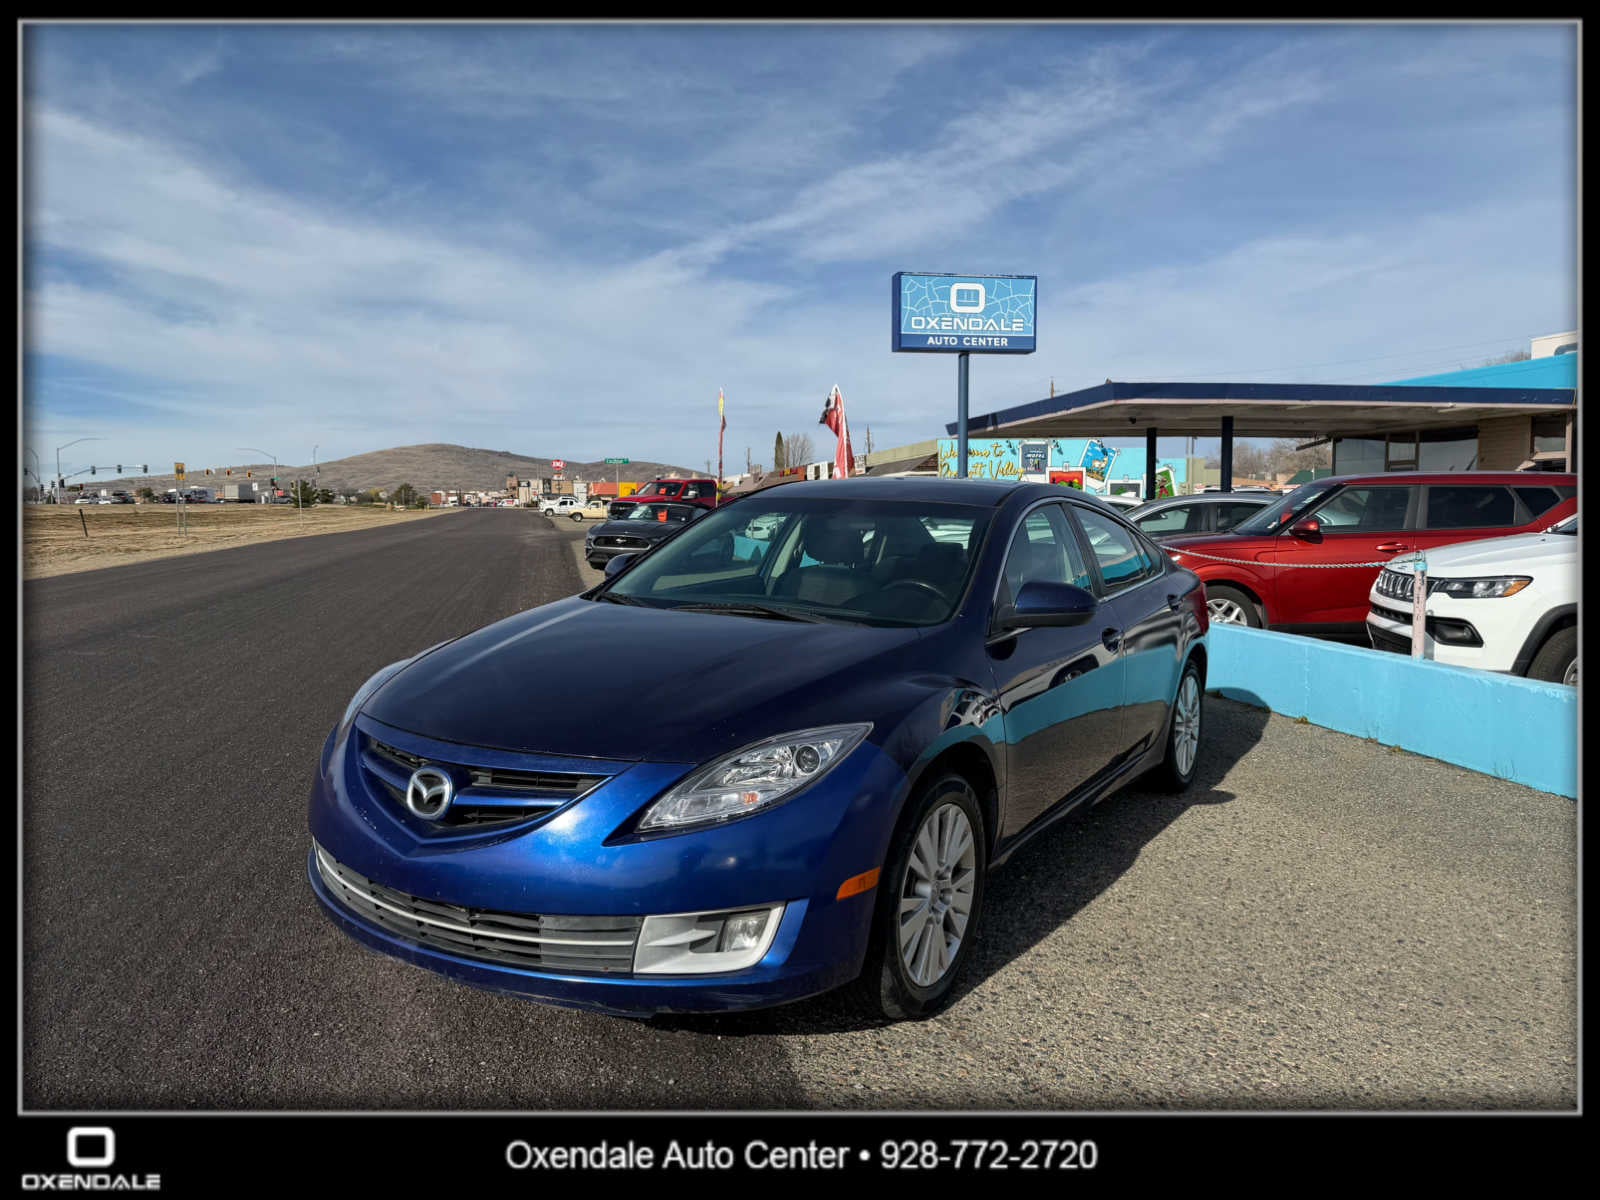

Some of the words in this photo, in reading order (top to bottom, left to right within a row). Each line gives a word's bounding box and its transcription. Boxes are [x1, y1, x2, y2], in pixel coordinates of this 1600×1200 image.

[911, 316, 1025, 332] OXENDALE
[927, 336, 958, 346] AUTO
[963, 337, 1008, 347] CENTER
